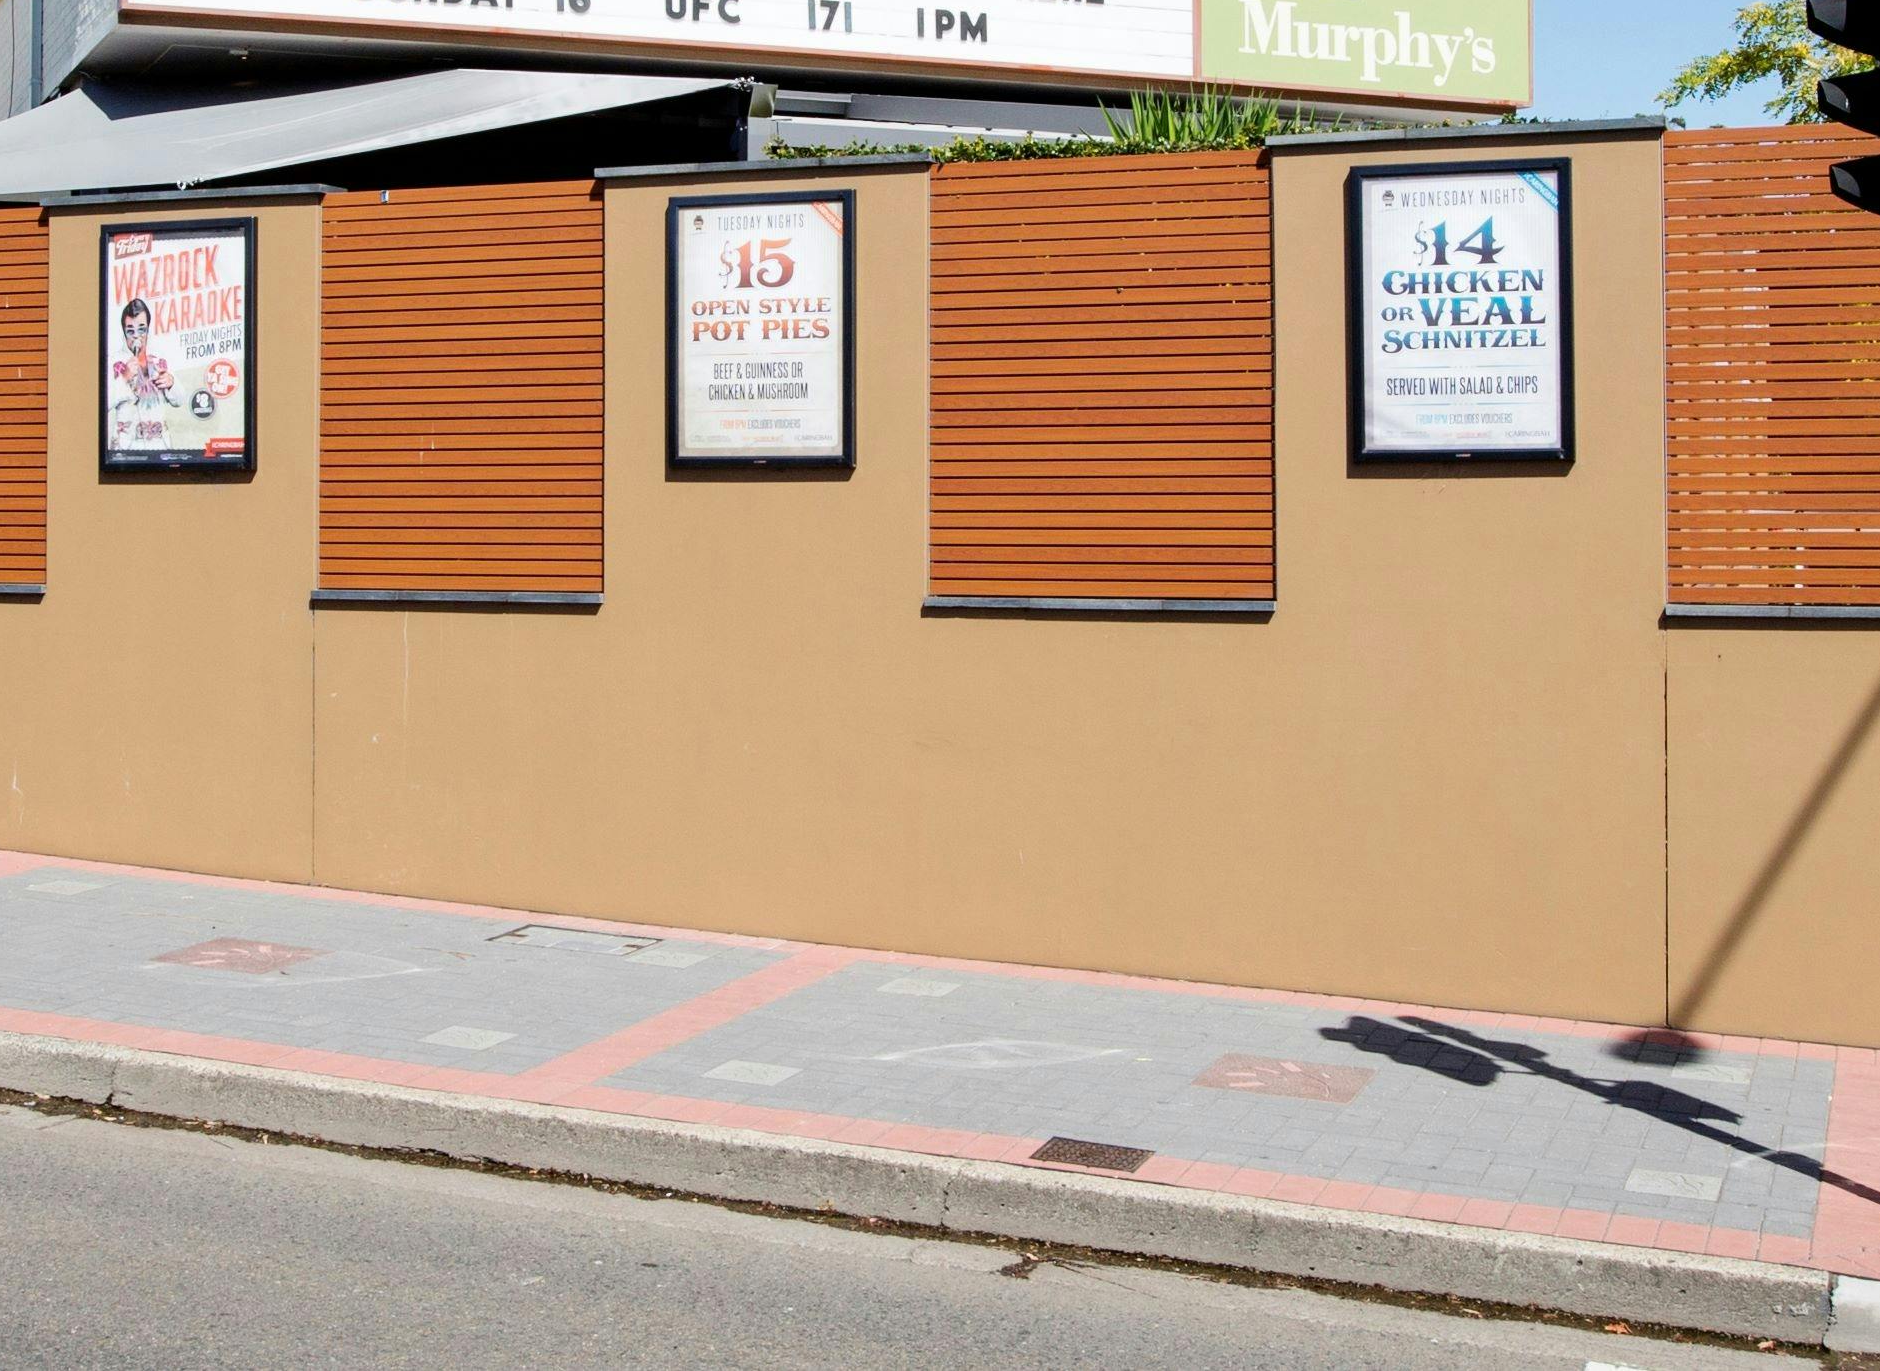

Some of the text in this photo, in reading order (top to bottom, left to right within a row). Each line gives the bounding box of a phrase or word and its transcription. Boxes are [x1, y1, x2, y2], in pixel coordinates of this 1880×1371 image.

[917, 7, 988, 43] 1PM
[1401, 188, 1525, 207] WEDNESDAY NIGHTS
[718, 215, 761, 231] TUESDAY
[767, 214, 804, 229] NIGHTS
[1413, 215, 1505, 266] $14
[113, 244, 219, 306] WAZROCK
[719, 238, 796, 289] $15
[1381, 269, 1544, 295] CHICKEN
[154, 285, 243, 335] KARAOKE
[691, 297, 831, 316] OPEN STYLE
[1381, 296, 1546, 326] OR VEAL
[180, 324, 242, 347] FRIDAY NIGHTS
[692, 318, 831, 342] POT PIES
[1381, 328, 1546, 353] SCHNITZEL
[186, 338, 242, 360] FROM 8PM
[713, 362, 803, 379] BEEF & GUINNESS OR
[709, 382, 808, 401] CHICKEN & MUSHROOM
[1387, 376, 1538, 396] SERVED WITH SALAD & CHIPS
[1449, 414, 1480, 425] EXCLUDES
[1481, 413, 1513, 425] VOUCHERS
